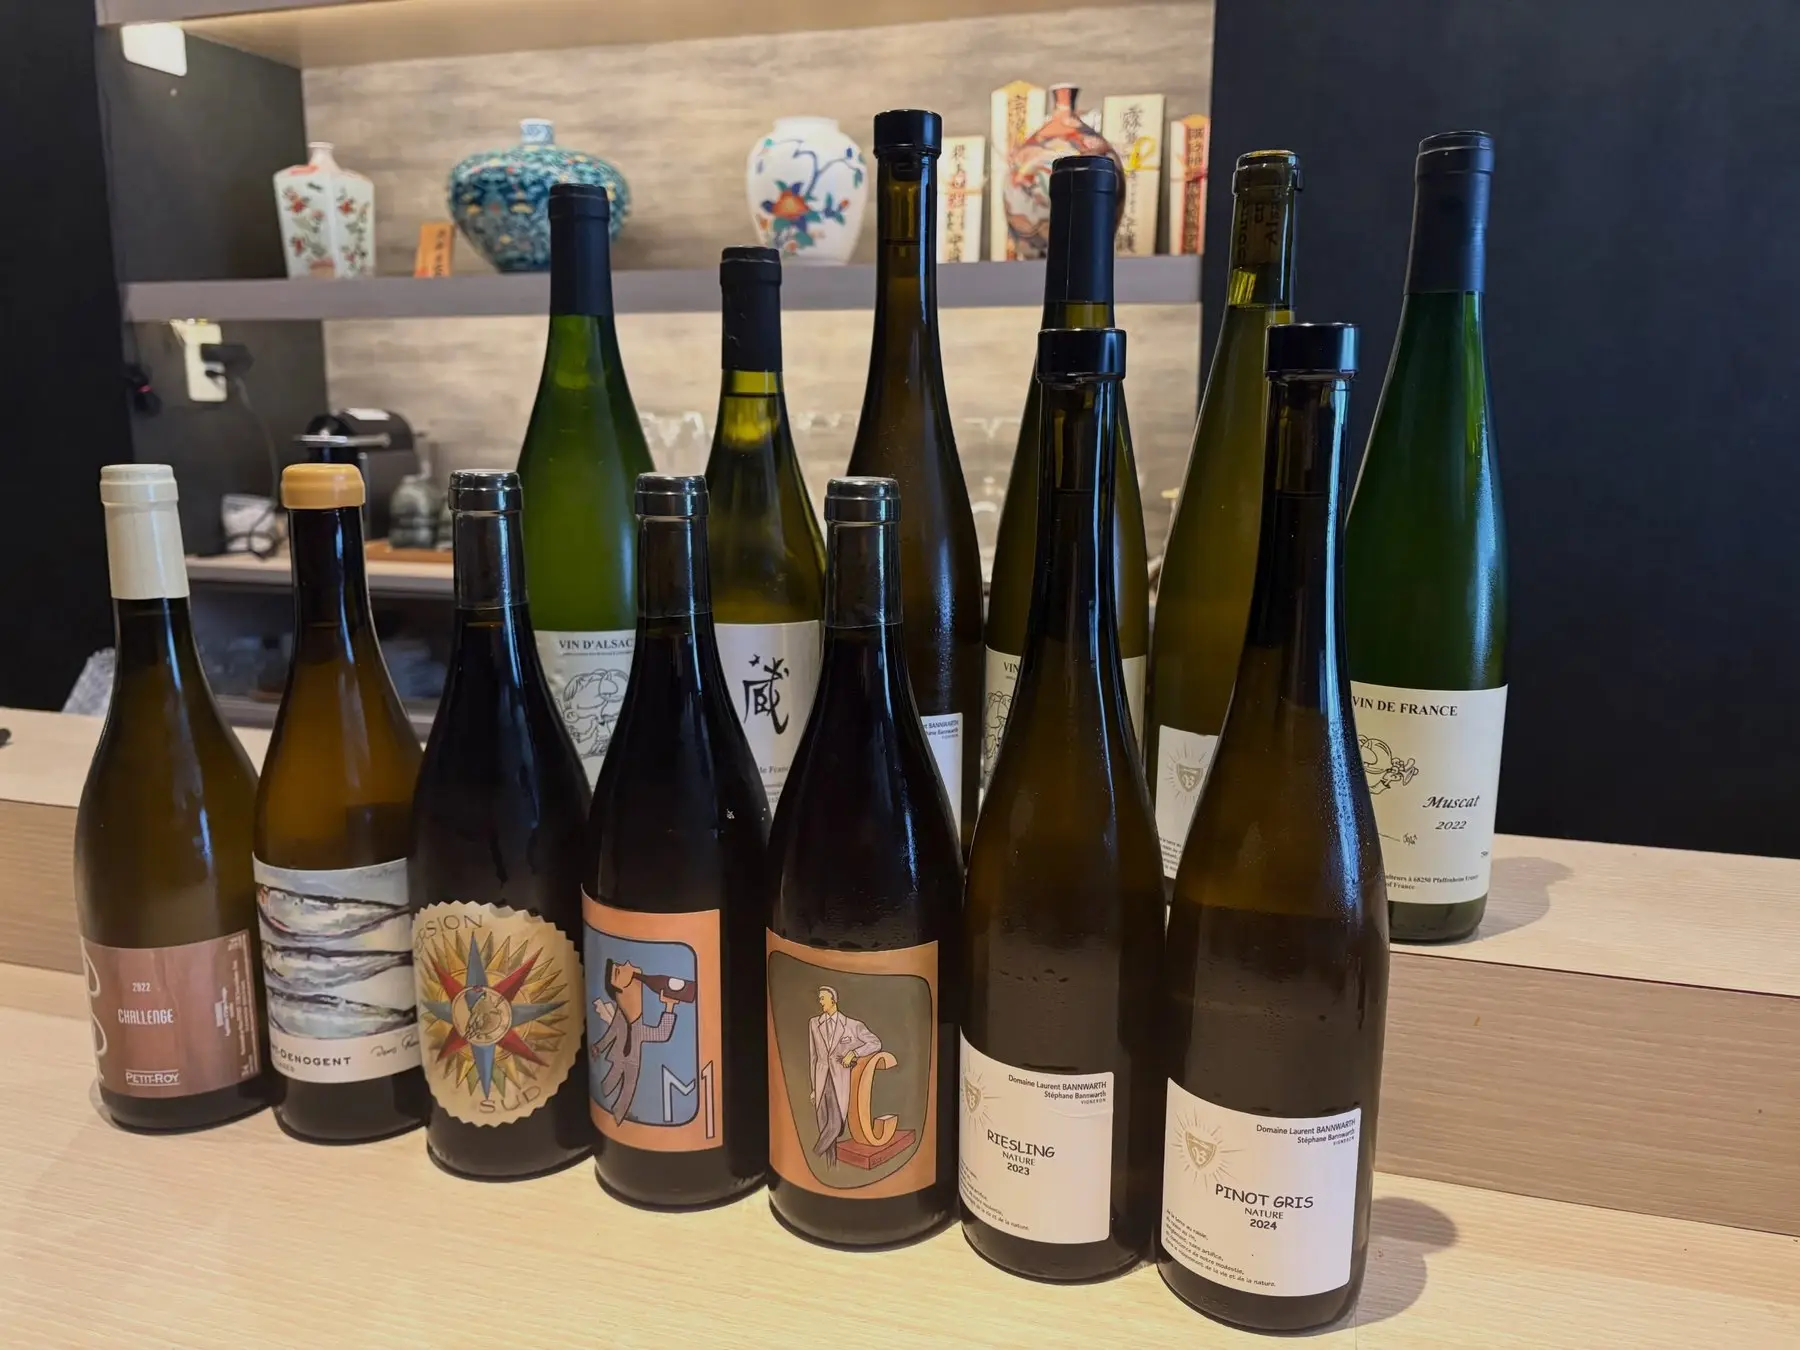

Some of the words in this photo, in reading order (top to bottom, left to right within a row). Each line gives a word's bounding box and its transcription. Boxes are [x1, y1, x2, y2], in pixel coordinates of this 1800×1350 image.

[559, 640, 580, 649] VIN
[583, 638, 634, 649] D'ALSAC
[1353, 696, 1374, 710] VIN
[1377, 700, 1395, 713] DE
[1400, 703, 1458, 716] FRANCE
[1422, 795, 1480, 808] Muscat
[1435, 820, 1467, 830] 2022
[132, 982, 151, 992] 2022
[118, 1008, 174, 1025] CHALLENGE
[125, 1072, 180, 1084] PETIT-ROY
[1008, 1074, 1036, 1087] Domaine
[1036, 1081, 1060, 1090] Laurent
[1062, 1081, 1107, 1090] BANNWARTH
[479, 1086, 541, 1114] SUD
[1044, 1090, 1074, 1100] Stéphane
[1074, 1090, 1106, 1099] Bannwarth
[1256, 1124, 1288, 1134] Domaine
[1289, 1127, 1315, 1135] Laurent
[1316, 1118, 1356, 1134] BANNWARTH
[986, 1128, 1056, 1159] RIESLING
[1297, 1136, 1327, 1145] Stéphane
[1328, 1128, 1355, 1141] Bannwarth
[1002, 1150, 1036, 1166] NATURE
[1006, 1162, 1030, 1176] 2023
[1215, 1183, 1270, 1206] PINOT
[1273, 1196, 1314, 1208] GRIS
[1244, 1208, 1284, 1220] NATURE
[1250, 1218, 1278, 1230] 2024
